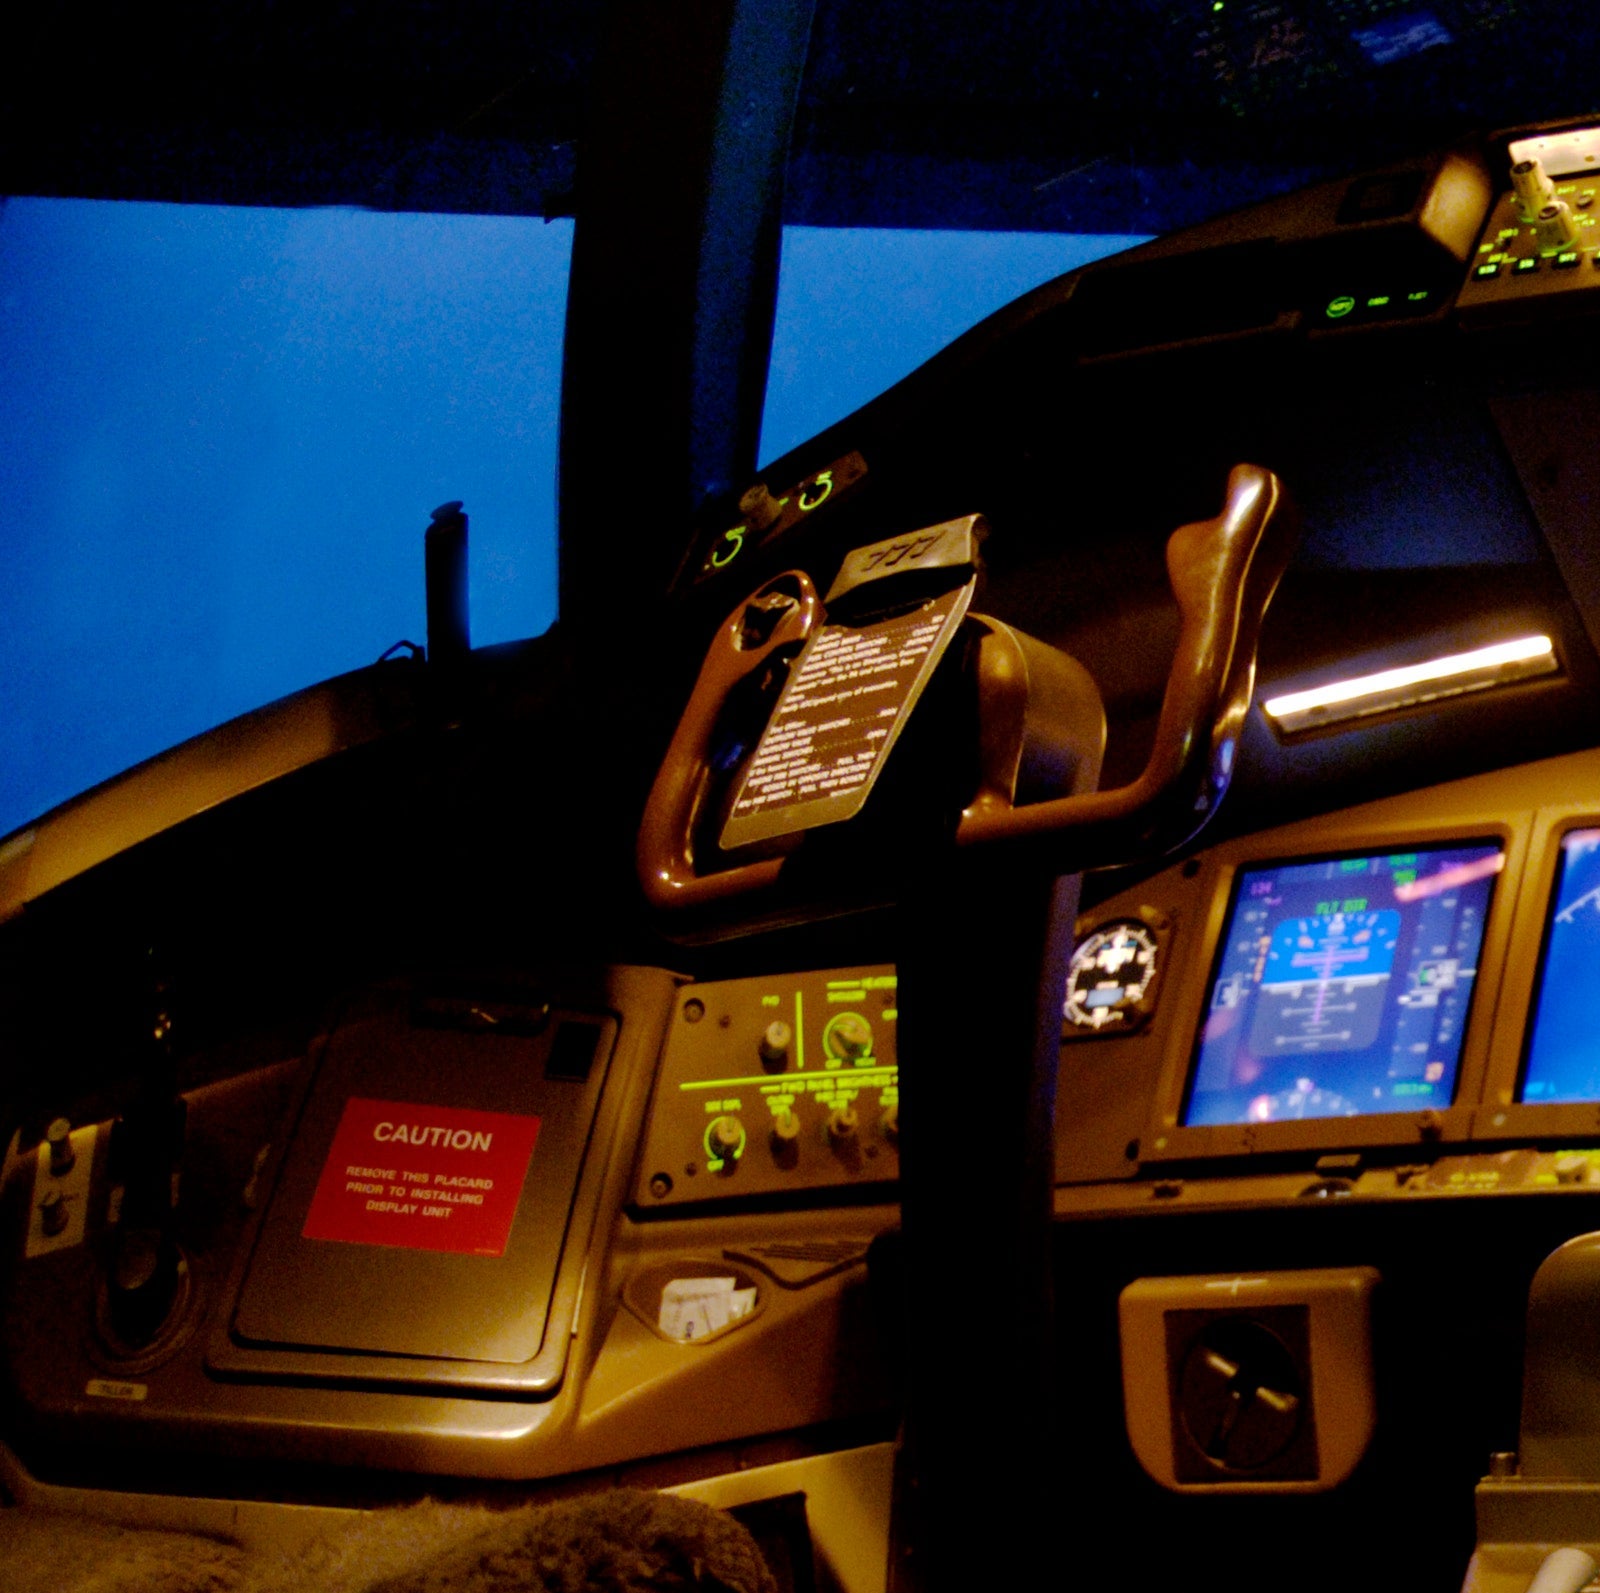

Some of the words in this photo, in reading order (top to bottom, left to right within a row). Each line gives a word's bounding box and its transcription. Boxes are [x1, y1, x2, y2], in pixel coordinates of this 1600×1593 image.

[861, 530, 948, 572] 777
[373, 1122, 493, 1152] CAUTION
[346, 1166, 396, 1180] REMOVE
[403, 1171, 429, 1184] THIS
[434, 1175, 493, 1190] PLACARD
[346, 1182, 383, 1195] PRIOR
[389, 1186, 406, 1197] TO
[411, 1189, 483, 1205] INSTALLING
[366, 1201, 417, 1214] DISPLAY
[423, 1207, 452, 1218] UNIT
